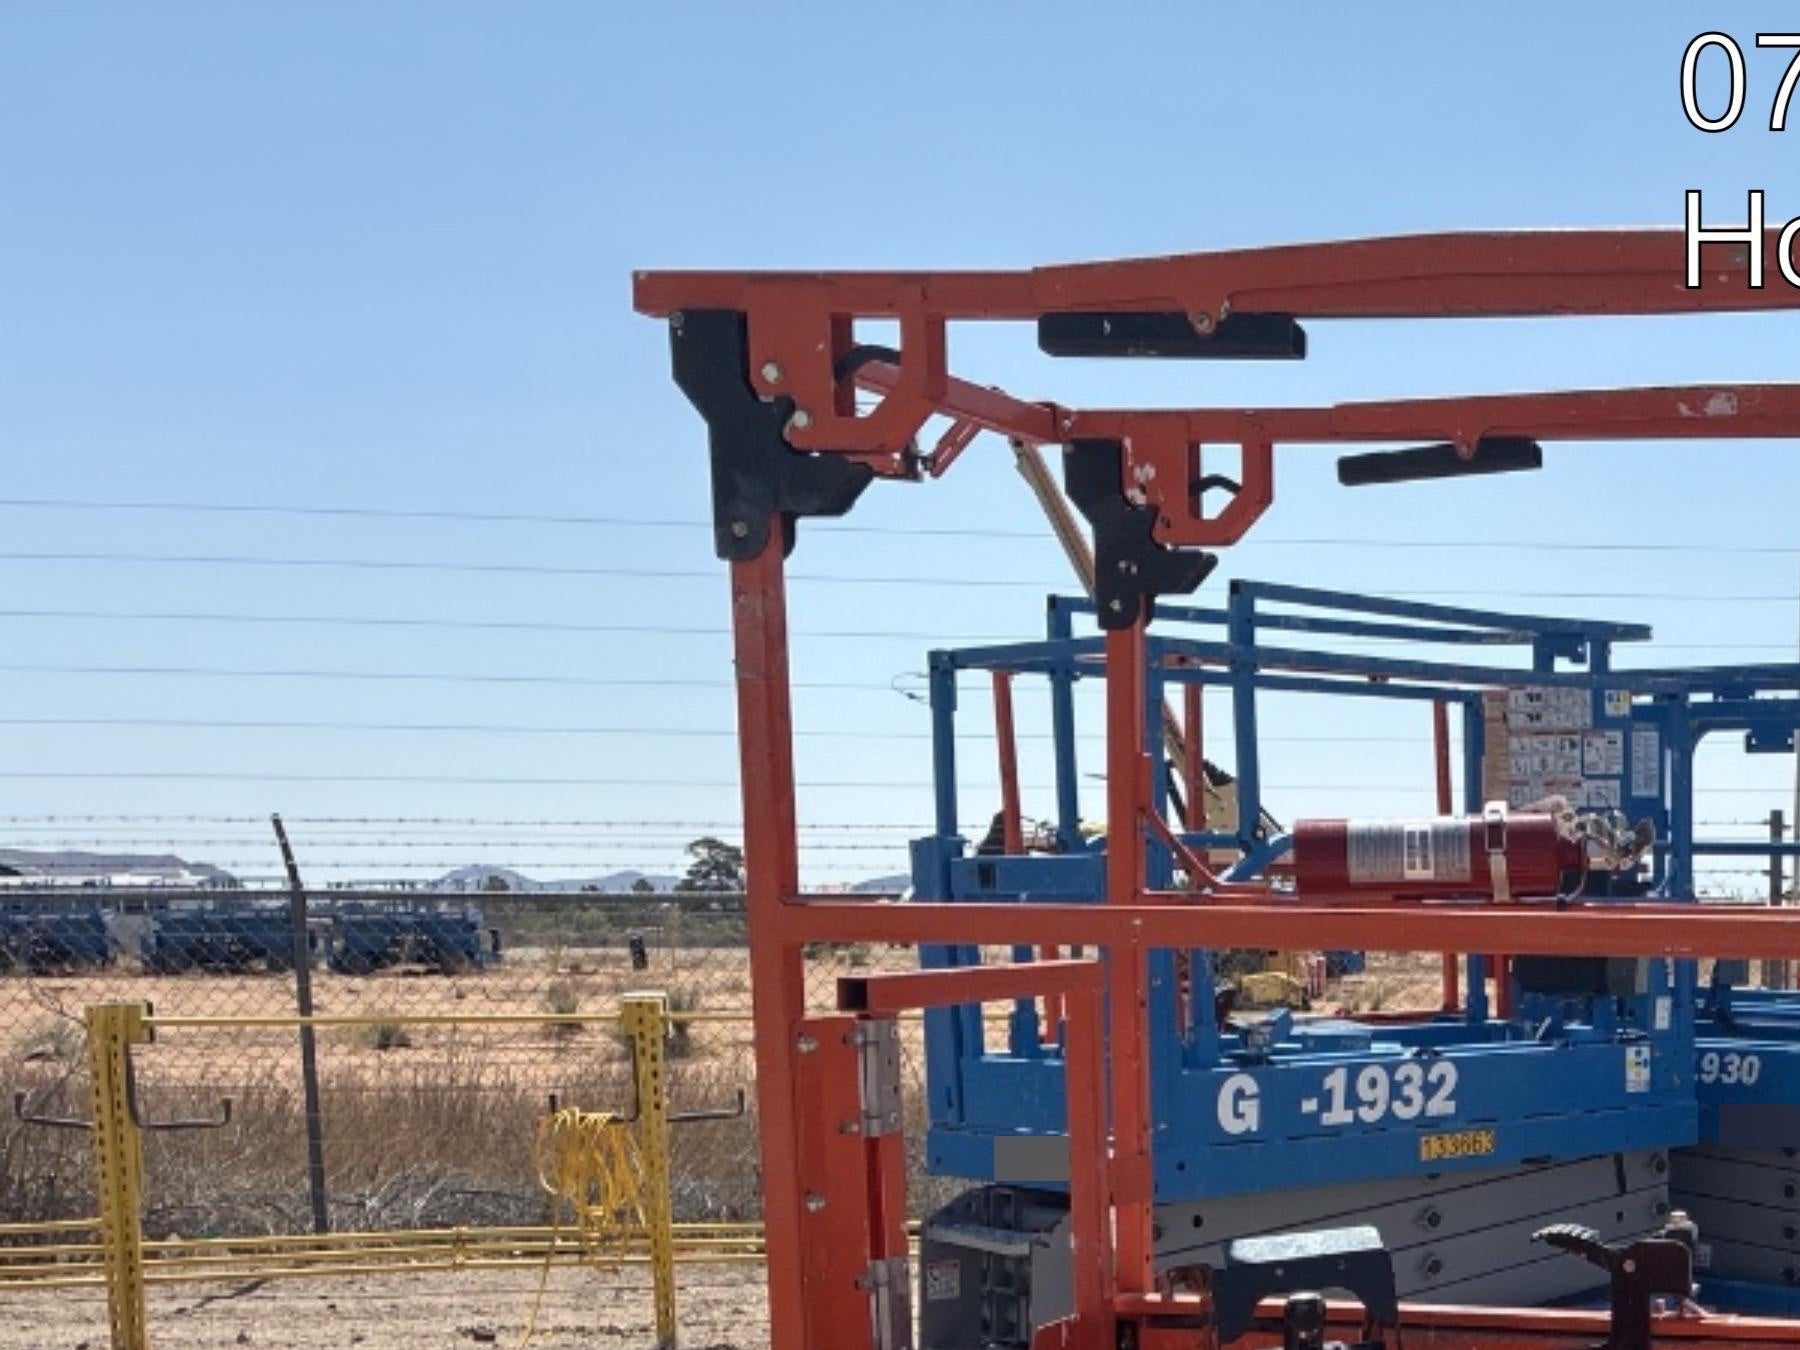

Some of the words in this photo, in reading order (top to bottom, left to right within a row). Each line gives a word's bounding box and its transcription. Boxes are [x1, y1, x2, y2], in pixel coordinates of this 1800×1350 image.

[1693, 1052, 1763, 1086] 930
[1216, 1074, 1261, 1134] G
[1301, 1061, 1459, 1125] -1932
